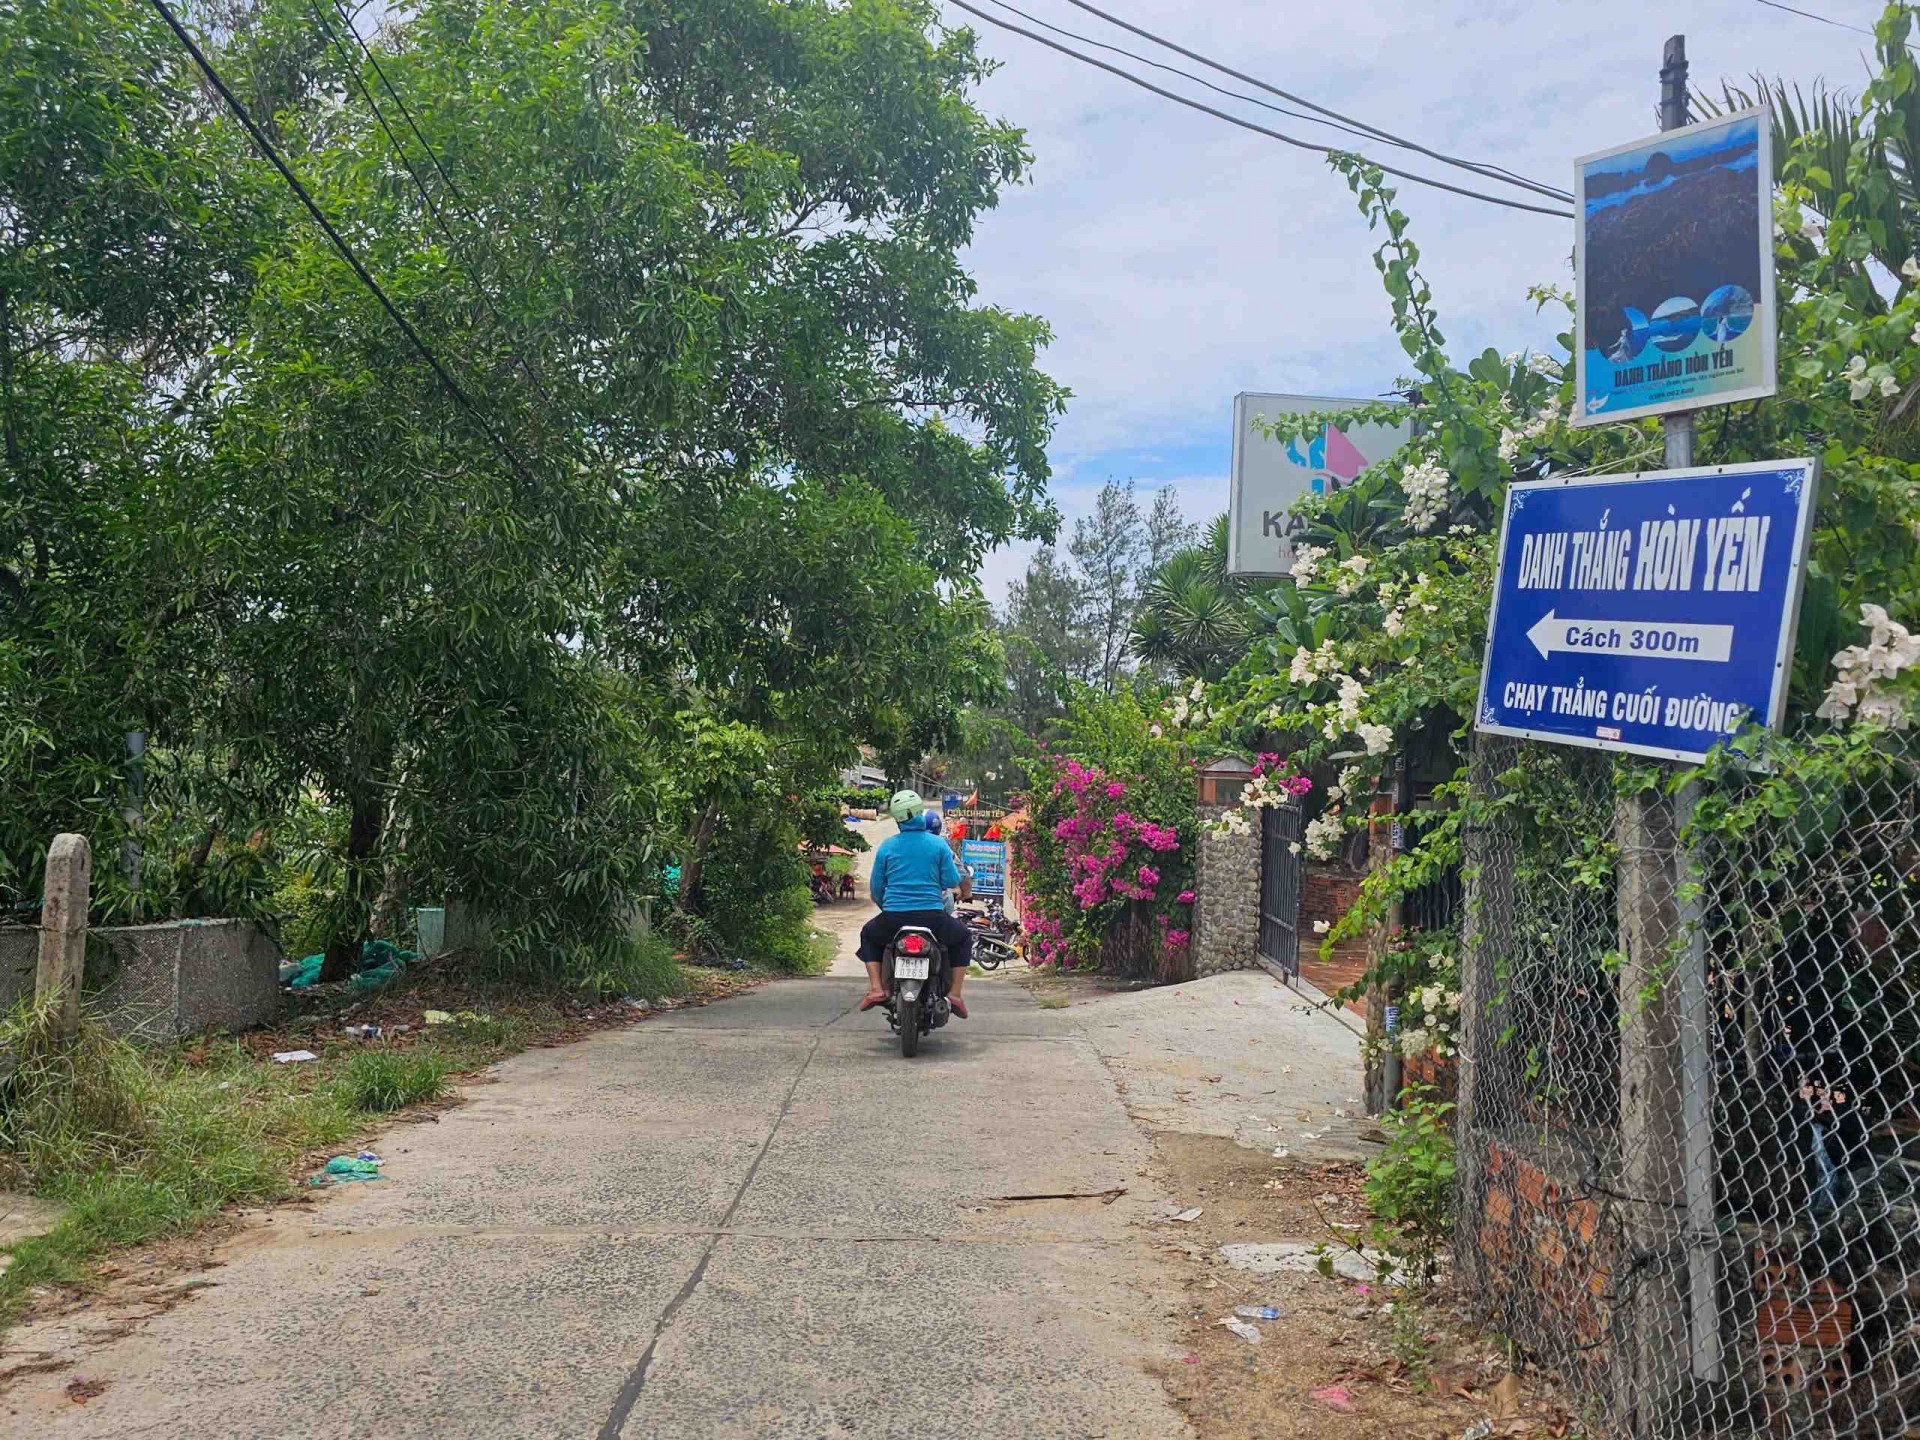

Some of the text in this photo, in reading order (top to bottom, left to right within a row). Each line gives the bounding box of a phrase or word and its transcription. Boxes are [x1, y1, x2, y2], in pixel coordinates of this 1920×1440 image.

[1614, 366, 1644, 388] DANH
[1517, 486, 1771, 592] DANH THẮNG HÒN YẾN
[1565, 626, 1699, 653] Cách 300m
[1503, 676, 1740, 735] CHẠY THẲNG CUỐI ĐƯỜNG
